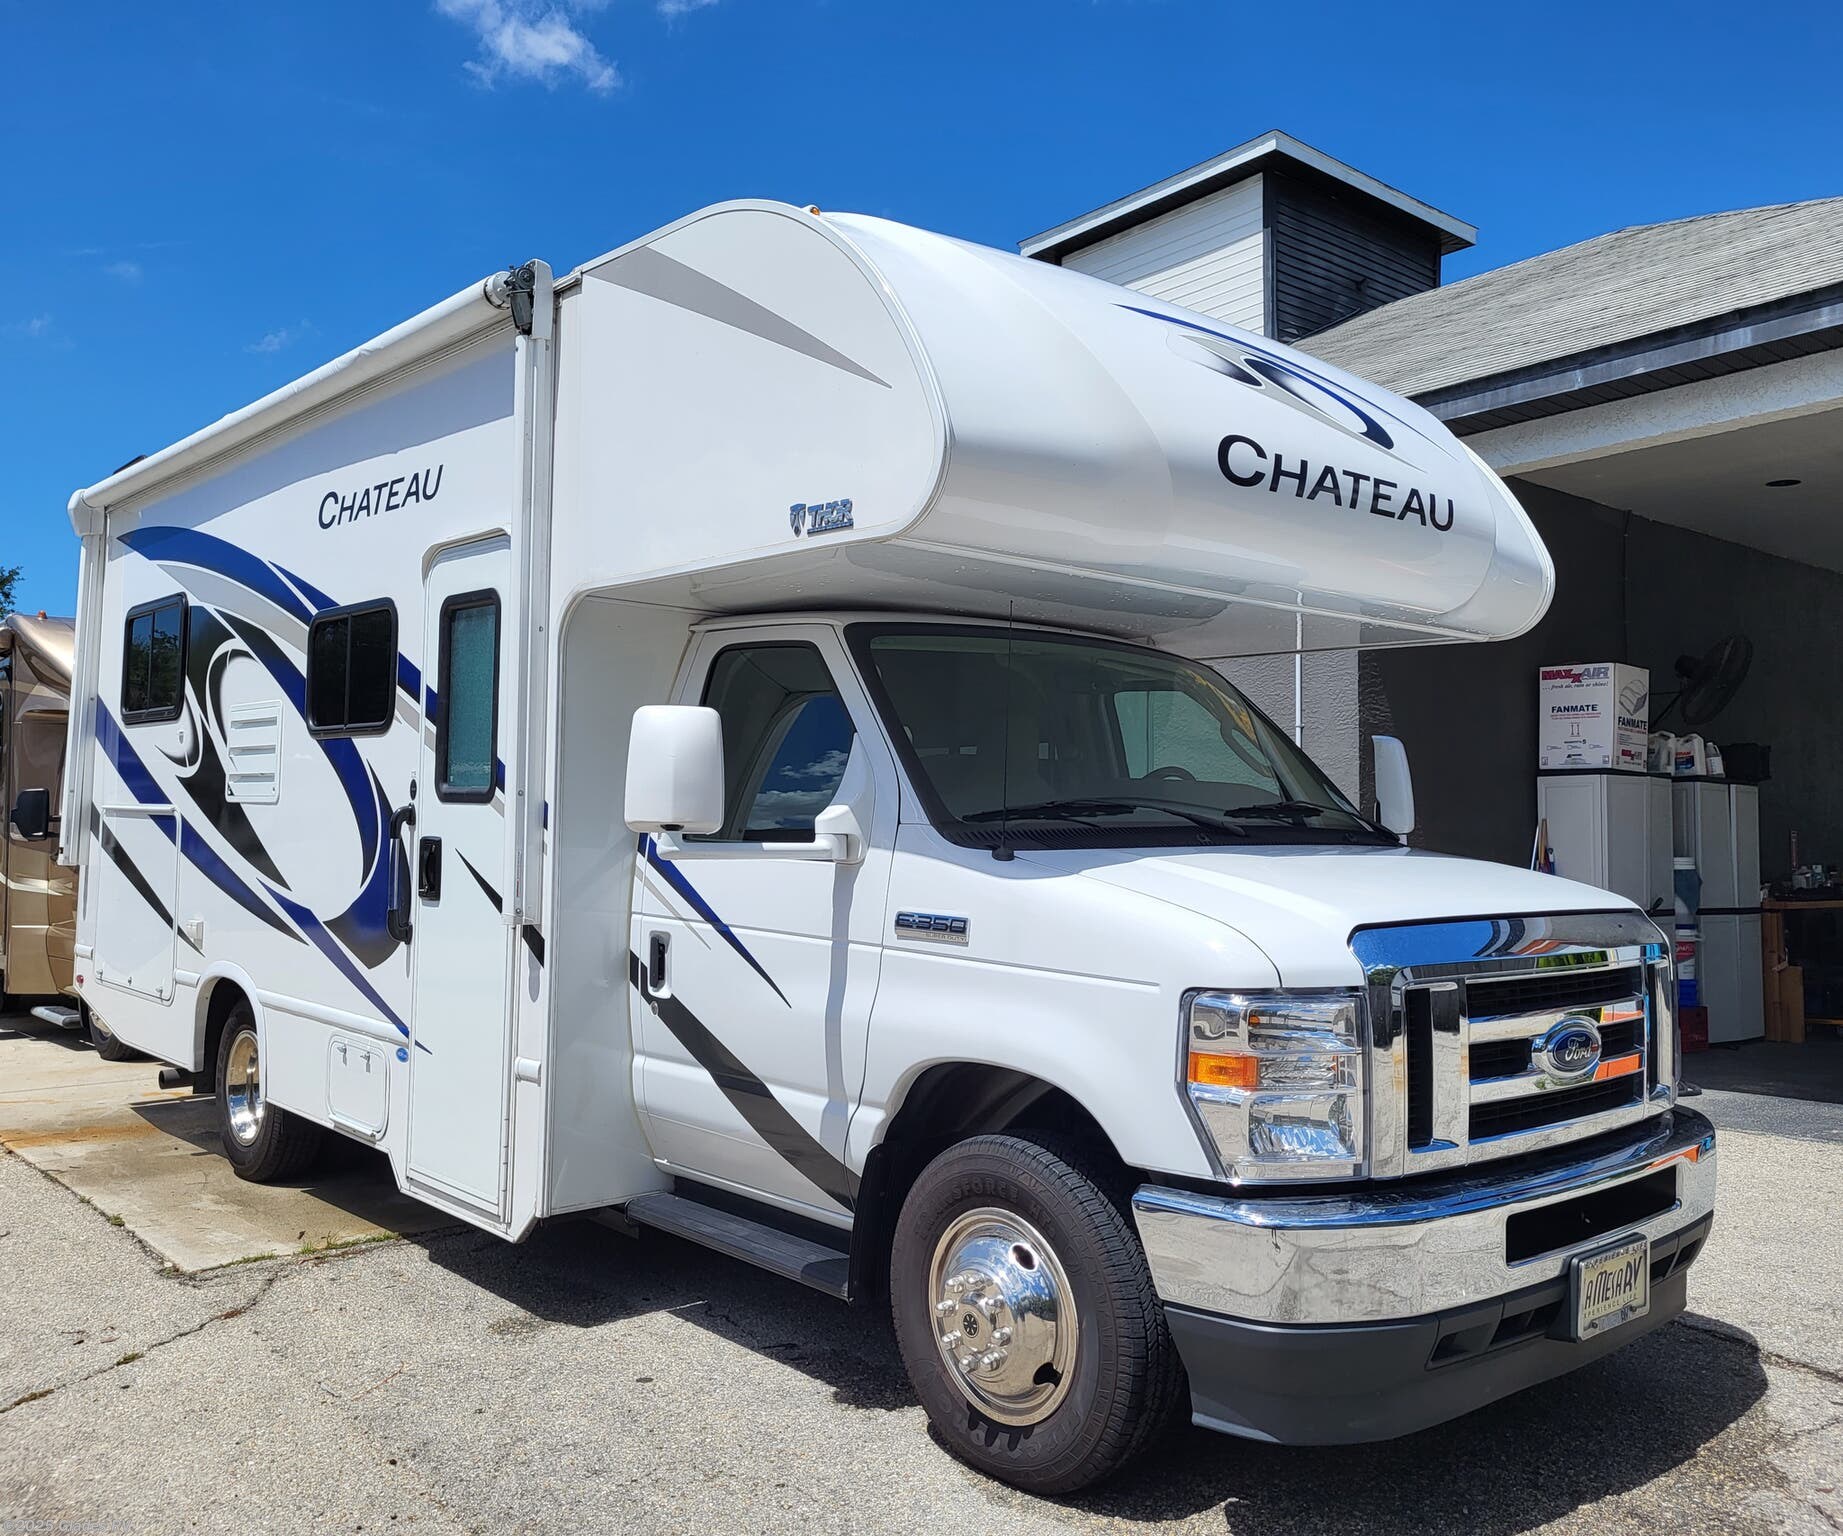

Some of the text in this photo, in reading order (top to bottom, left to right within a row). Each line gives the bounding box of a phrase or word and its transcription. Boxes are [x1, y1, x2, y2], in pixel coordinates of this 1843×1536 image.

[1217, 434, 1455, 532] CHATEAU
[318, 464, 443, 530] CHATEAU
[807, 499, 853, 528] THOR
[1551, 704, 1598, 714] FANMATE
[1618, 716, 1648, 730] FANMATE
[1565, 1036, 1593, 1061] Ford
[1584, 1298, 1620, 1320] XPERIENCE
